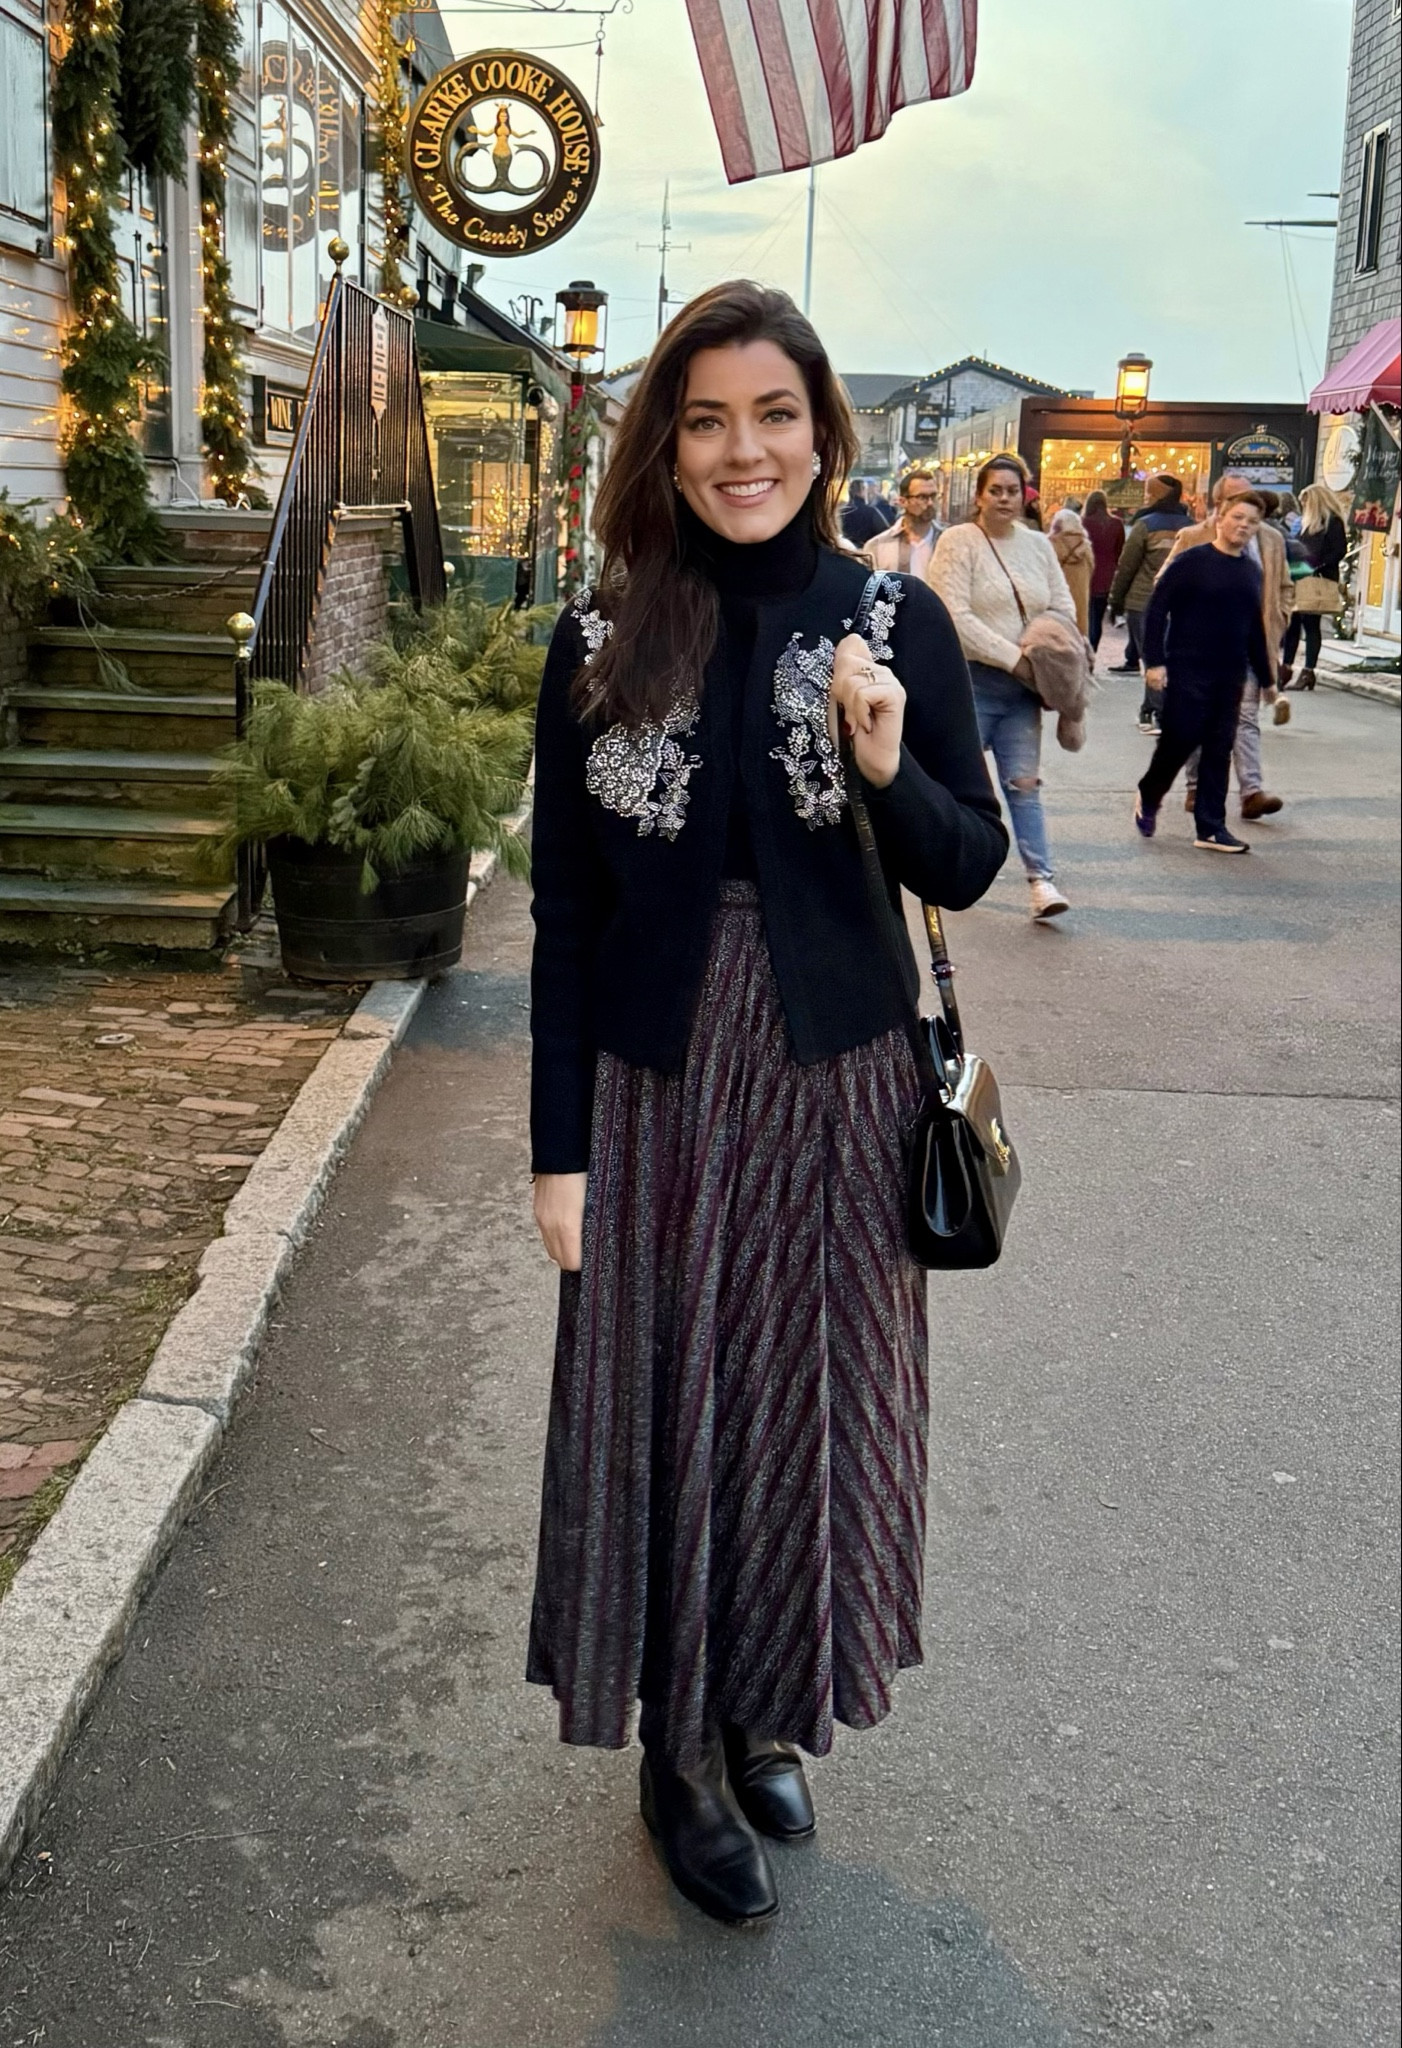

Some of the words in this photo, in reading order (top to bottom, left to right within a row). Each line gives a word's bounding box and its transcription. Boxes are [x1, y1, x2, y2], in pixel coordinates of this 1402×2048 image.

[414, 73, 473, 170] CLARKE
[470, 60, 554, 103] COOKE
[545, 89, 591, 174] HOUSE
[428, 183, 460, 226] The
[463, 217, 528, 249] Candy
[532, 189, 578, 237] Store
[1366, 444, 1400, 468] Happy
